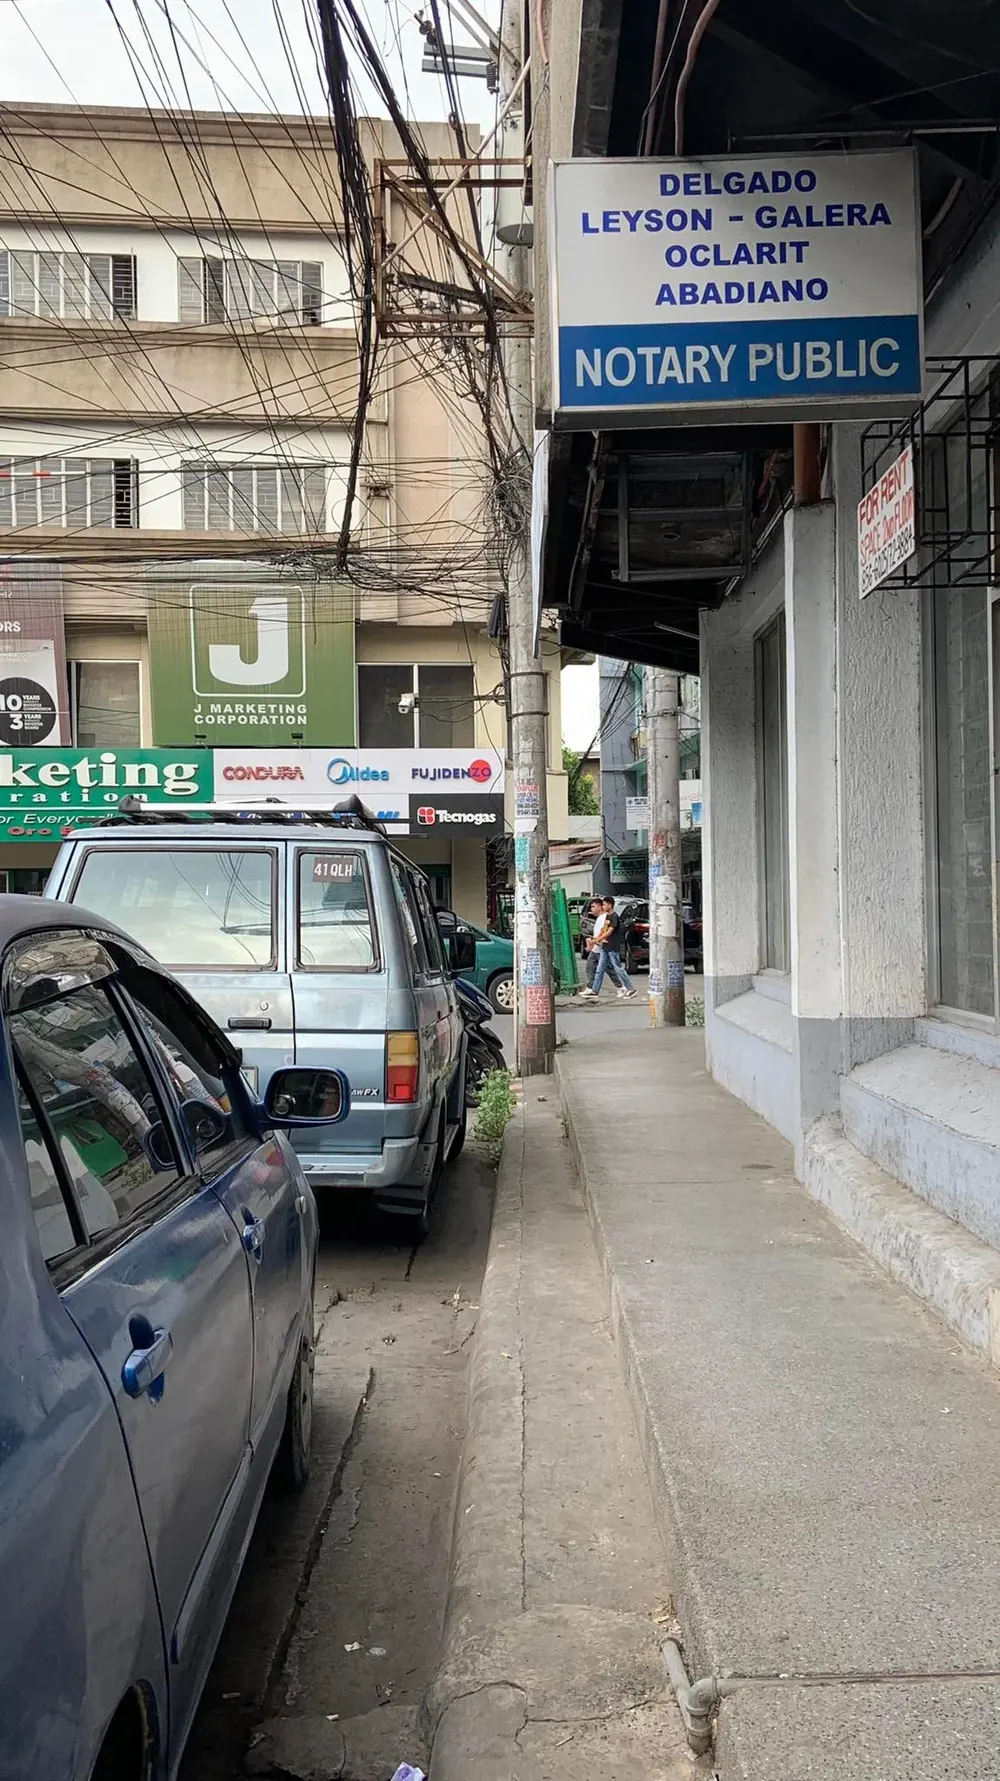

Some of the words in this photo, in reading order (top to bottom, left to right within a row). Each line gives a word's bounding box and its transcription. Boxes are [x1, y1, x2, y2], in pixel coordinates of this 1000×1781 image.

[659, 169, 817, 196] DELGADO
[581, 208, 712, 235] LEYSON
[755, 203, 892, 229] GALERA
[665, 240, 810, 268] OCLARIT
[655, 278, 828, 306] ABADIANO
[575, 344, 737, 388] NOTARY
[749, 337, 900, 383] PUBLIC
[860, 486, 879, 534] FOR
[881, 451, 909, 510] RENT
[208, 597, 289, 686] J
[0, 694, 22, 711] 10
[193, 704, 202, 714] J
[210, 704, 307, 714] MARKETING
[9, 713, 24, 730] 3
[194, 715, 307, 725] CORPORATION
[222, 765, 305, 780] CONDURA
[328, 758, 390, 784] Midea
[411, 766, 492, 781] FUJIDENZO
[436, 810, 496, 824] Tecnogas
[8, 826, 52, 836] Oro
